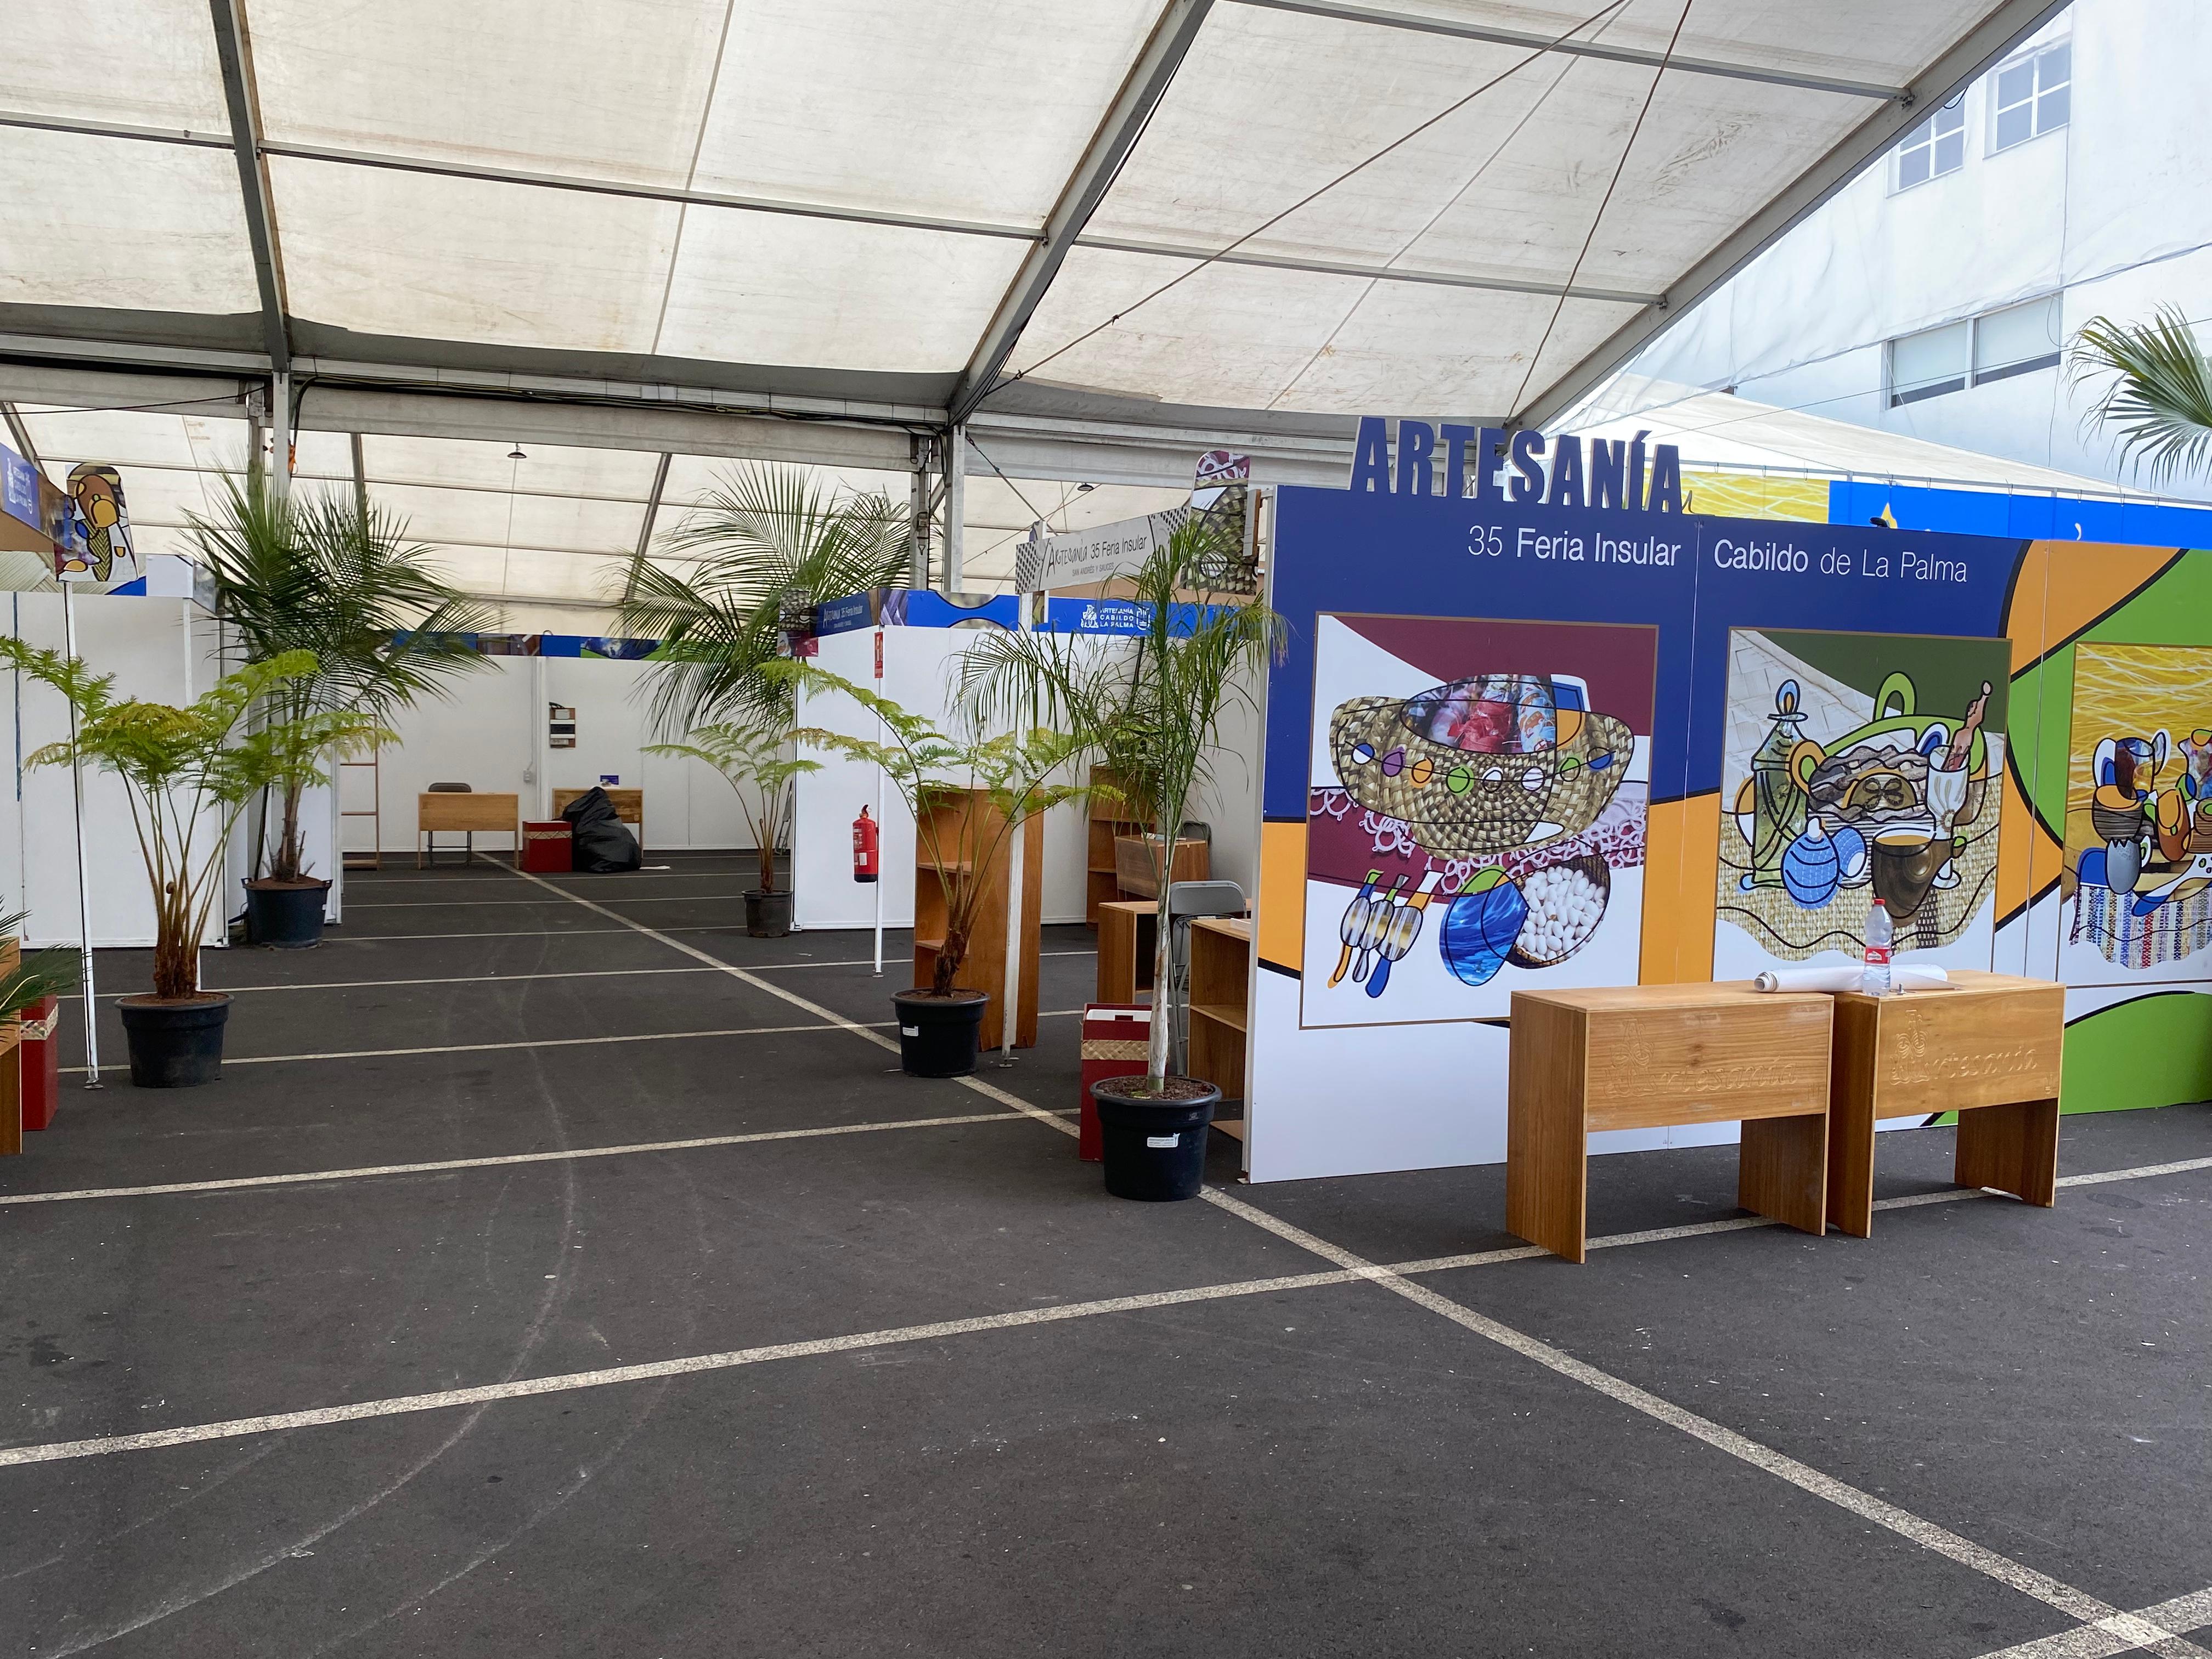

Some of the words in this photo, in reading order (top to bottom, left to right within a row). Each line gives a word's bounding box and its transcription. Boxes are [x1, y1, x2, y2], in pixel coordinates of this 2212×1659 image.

[1349, 416, 1683, 514] ARTESANÍA
[1090, 543, 1100, 560] 35
[1102, 540, 1120, 558] Feria
[1122, 534, 1147, 554] Insular
[1468, 525, 1503, 556] 35
[1516, 527, 1584, 561] Feria
[1595, 532, 1681, 566] Insular
[1714, 539, 1809, 573] Cabildo
[1820, 546, 1851, 575] de
[1861, 549, 1889, 578] La
[1900, 551, 1968, 583] Palma
